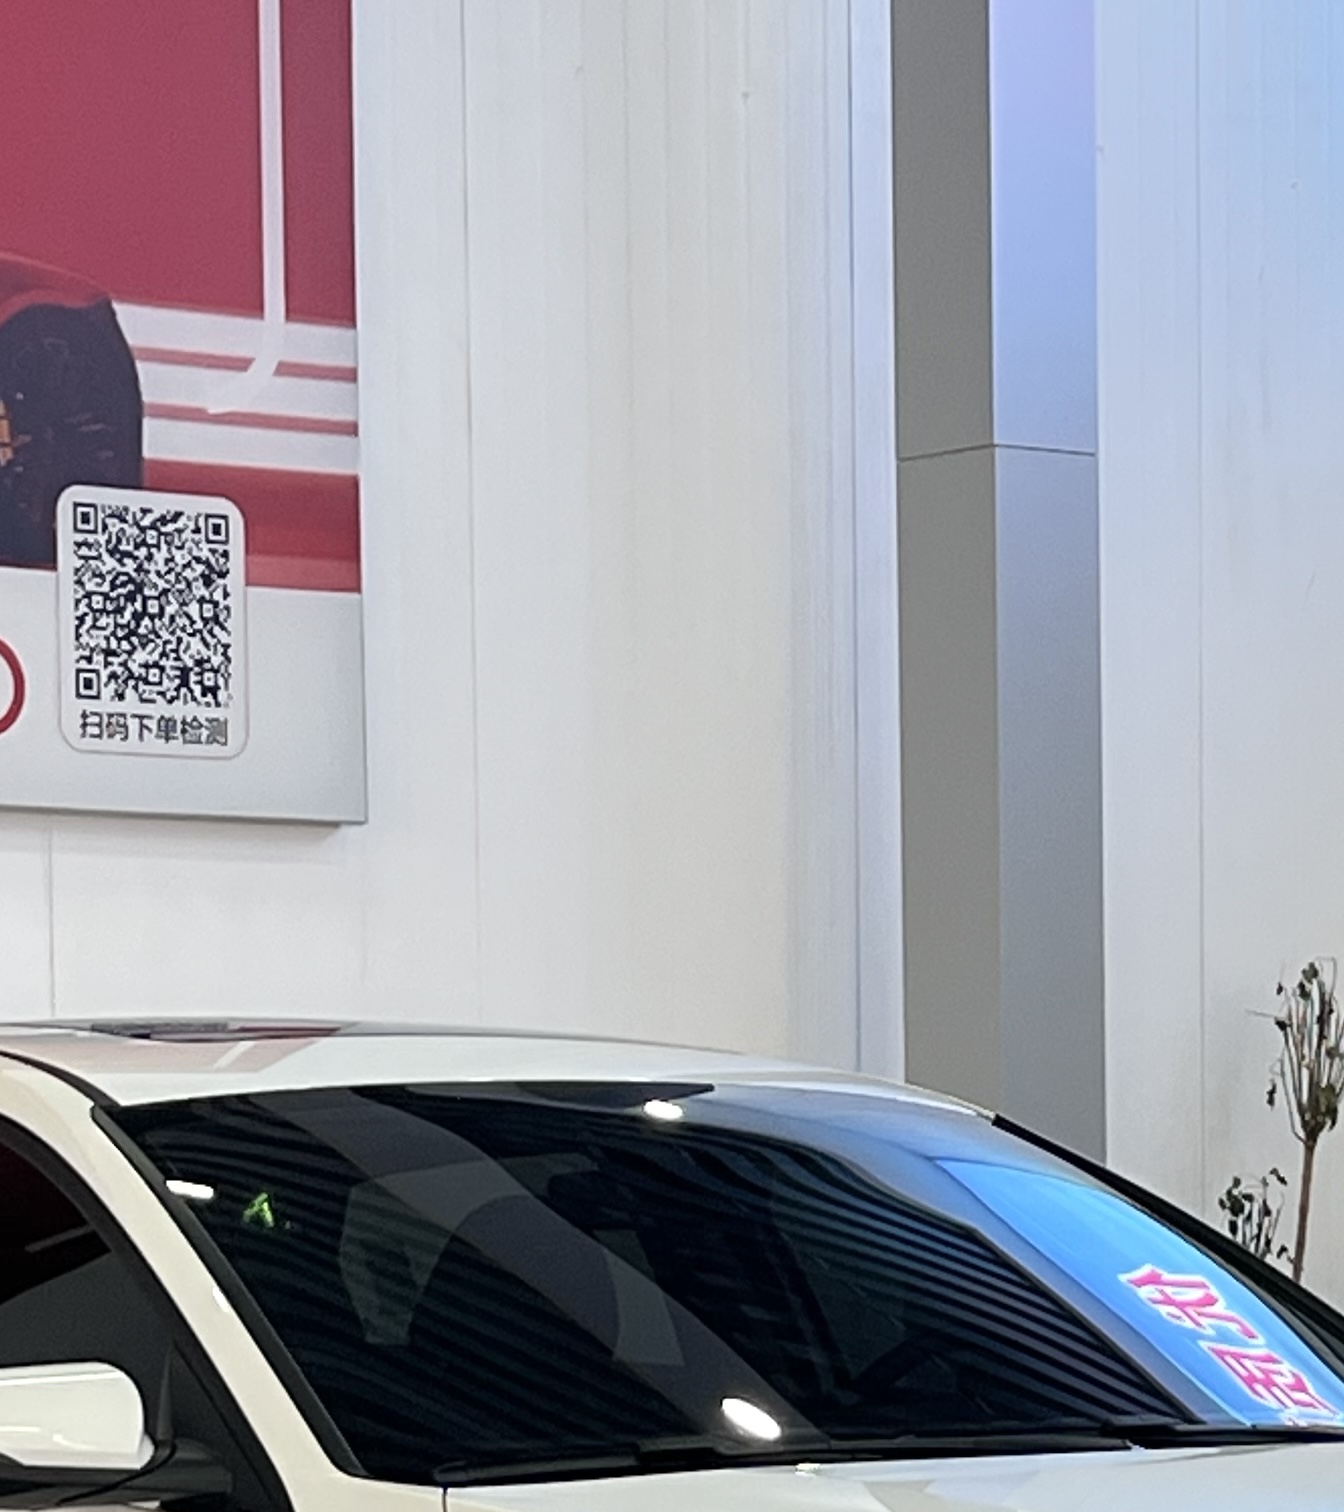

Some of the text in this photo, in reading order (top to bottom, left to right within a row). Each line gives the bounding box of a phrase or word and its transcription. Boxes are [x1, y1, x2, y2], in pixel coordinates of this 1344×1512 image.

[79, 708, 229, 747] 扫码下单检测
